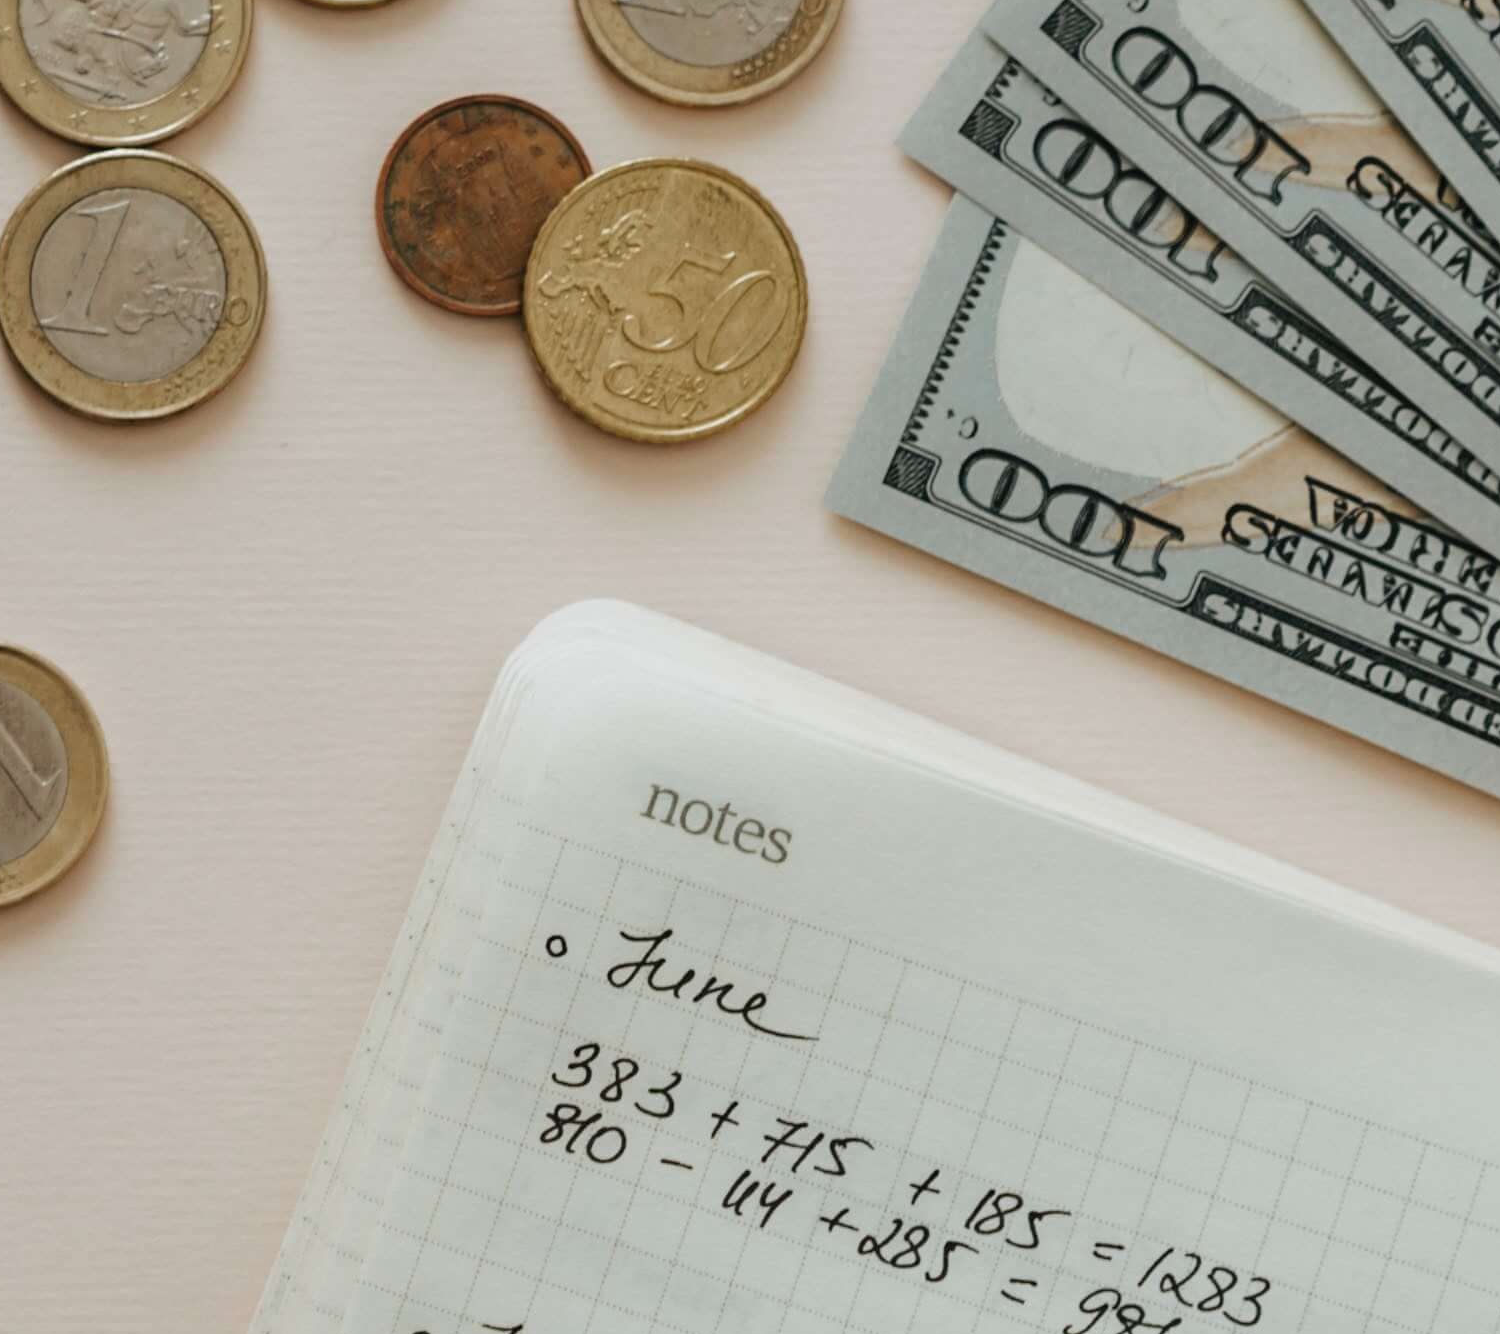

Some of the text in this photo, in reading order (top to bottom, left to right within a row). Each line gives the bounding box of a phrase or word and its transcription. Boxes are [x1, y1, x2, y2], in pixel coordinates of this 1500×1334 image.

[621, 242, 790, 374] 50
[640, 784, 793, 865] notes
[606, 928, 815, 1041] June
[539, 1103, 627, 1164] 810
[858, 1220, 978, 1282] 285
[549, 1042, 682, 1125] 383
[762, 1119, 875, 1177] 715
[963, 1188, 1072, 1254] 185
[1137, 1247, 1272, 1328] 1283
